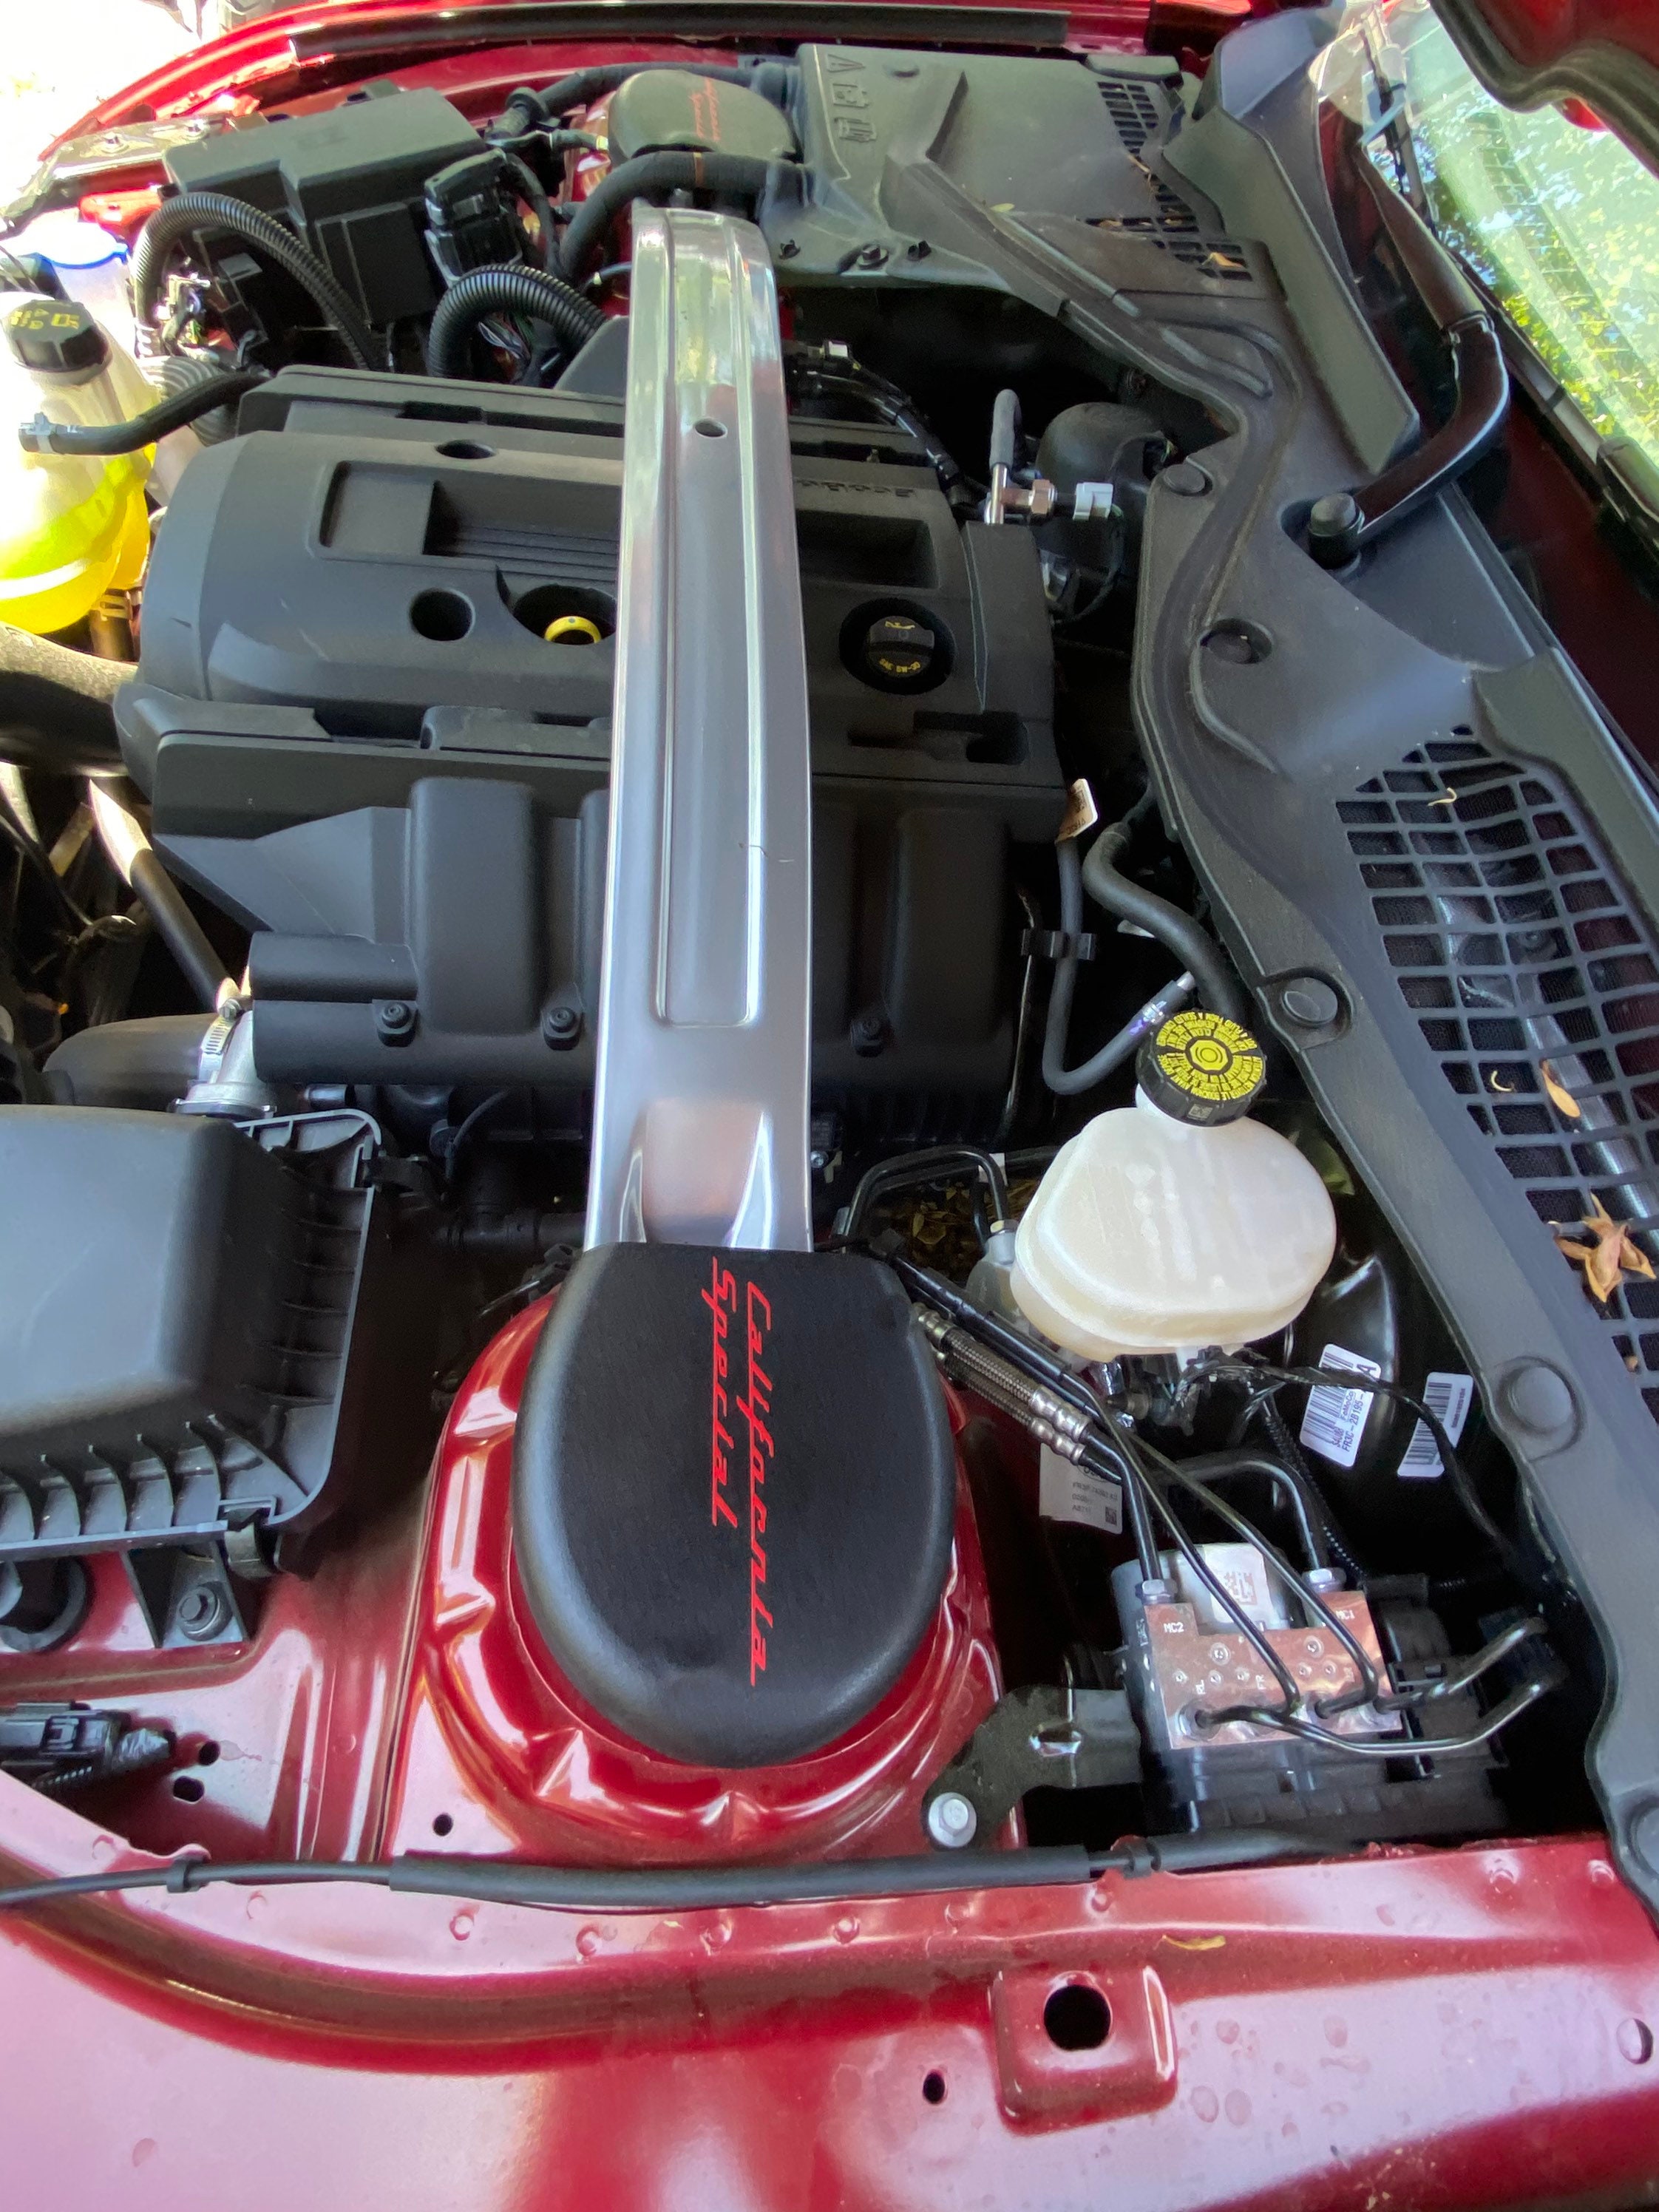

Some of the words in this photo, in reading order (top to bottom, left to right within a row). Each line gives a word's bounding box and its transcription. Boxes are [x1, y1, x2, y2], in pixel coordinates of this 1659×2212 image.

[879, 659, 892, 670] SAE
[896, 661, 921, 674] 5W-30
[1335, 1609, 1355, 1620] MC1
[1164, 1621, 1184, 1634] MC2
[1195, 1679, 1206, 1695] RL
